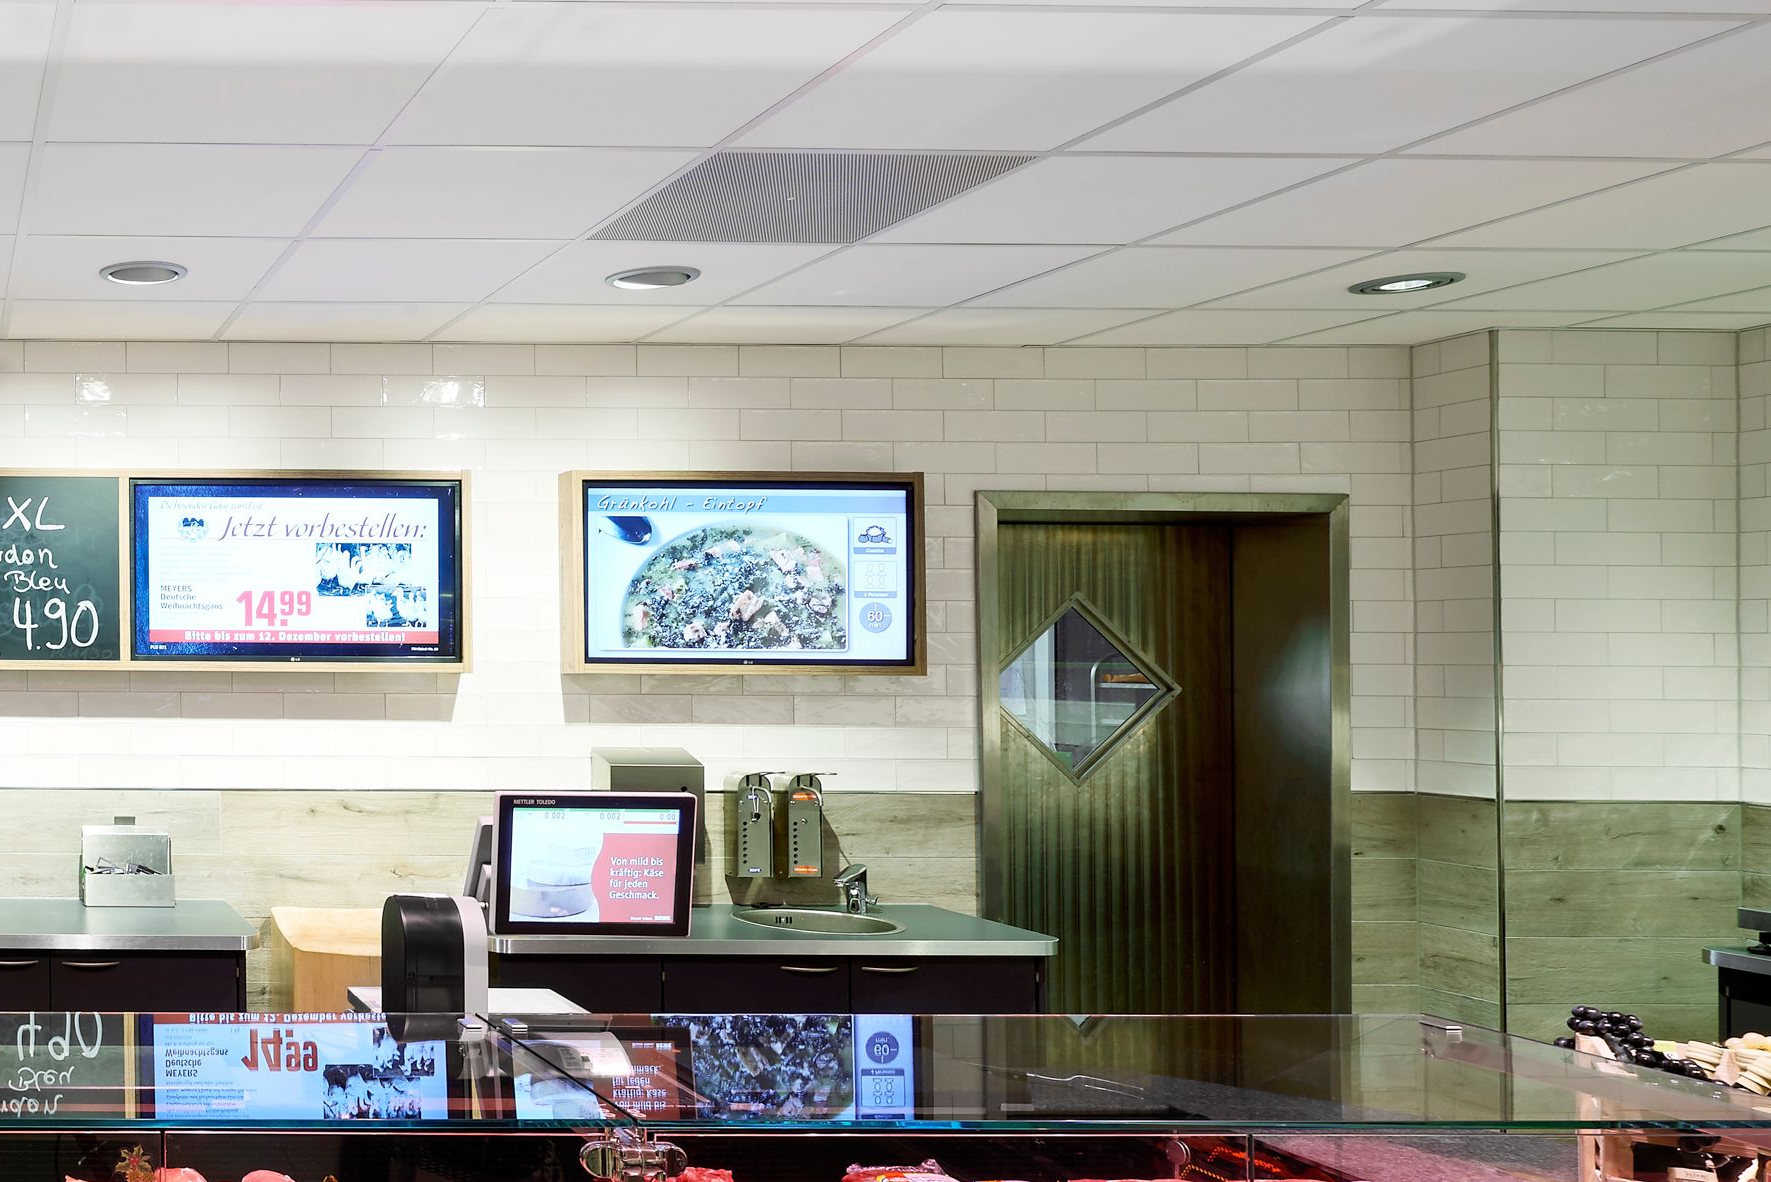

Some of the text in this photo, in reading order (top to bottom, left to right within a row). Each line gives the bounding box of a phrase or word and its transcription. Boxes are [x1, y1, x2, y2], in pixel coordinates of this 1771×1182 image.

[597, 494, 768, 514] Grünkohl Eintopf
[218, 512, 428, 541] Jetzt vorbestellen:
[4, 570, 71, 595] Bleu
[160, 584, 193, 593] MEYERS
[160, 593, 197, 601] Deutsche
[160, 602, 224, 611] Weihnachtsgans
[867, 610, 884, 622] 60
[13, 597, 100, 651] 4.90
[184, 631, 406, 642] Bitte bis zum 12. Dezember vorbestellen!
[610, 857, 664, 866] Von mild bis
[610, 867, 664, 879] kräftig: Käse
[609, 878, 648, 890] für jeden
[609, 890, 660, 899] Geschmack.
